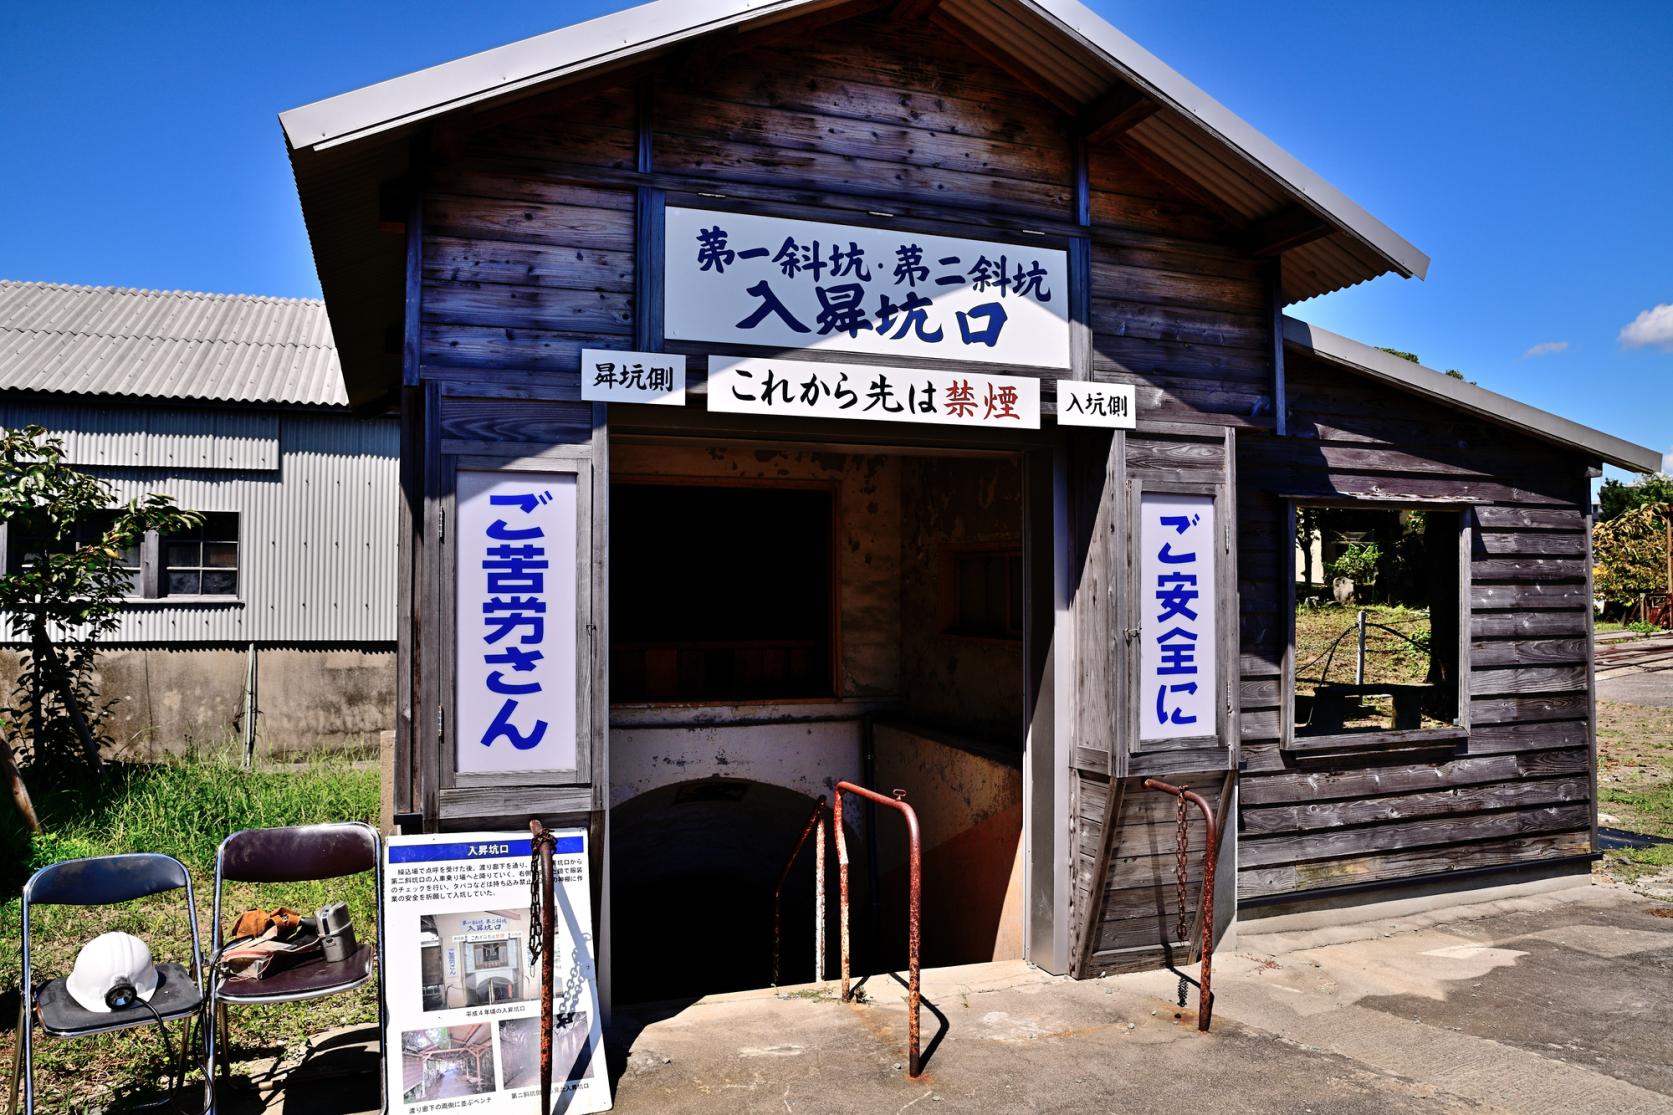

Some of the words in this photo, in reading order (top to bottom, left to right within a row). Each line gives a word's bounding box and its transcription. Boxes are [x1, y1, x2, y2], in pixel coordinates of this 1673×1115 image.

[735, 279, 1008, 348] 入昇坑口
[593, 363, 673, 392] 昇坑側
[731, 368, 1021, 420] これから先は禁煙
[1065, 390, 1128, 417] 入坑側
[480, 490, 553, 751] ご苦労さん
[1155, 513, 1200, 725] ご安全に
[467, 844, 509, 856] 入昇坑口
